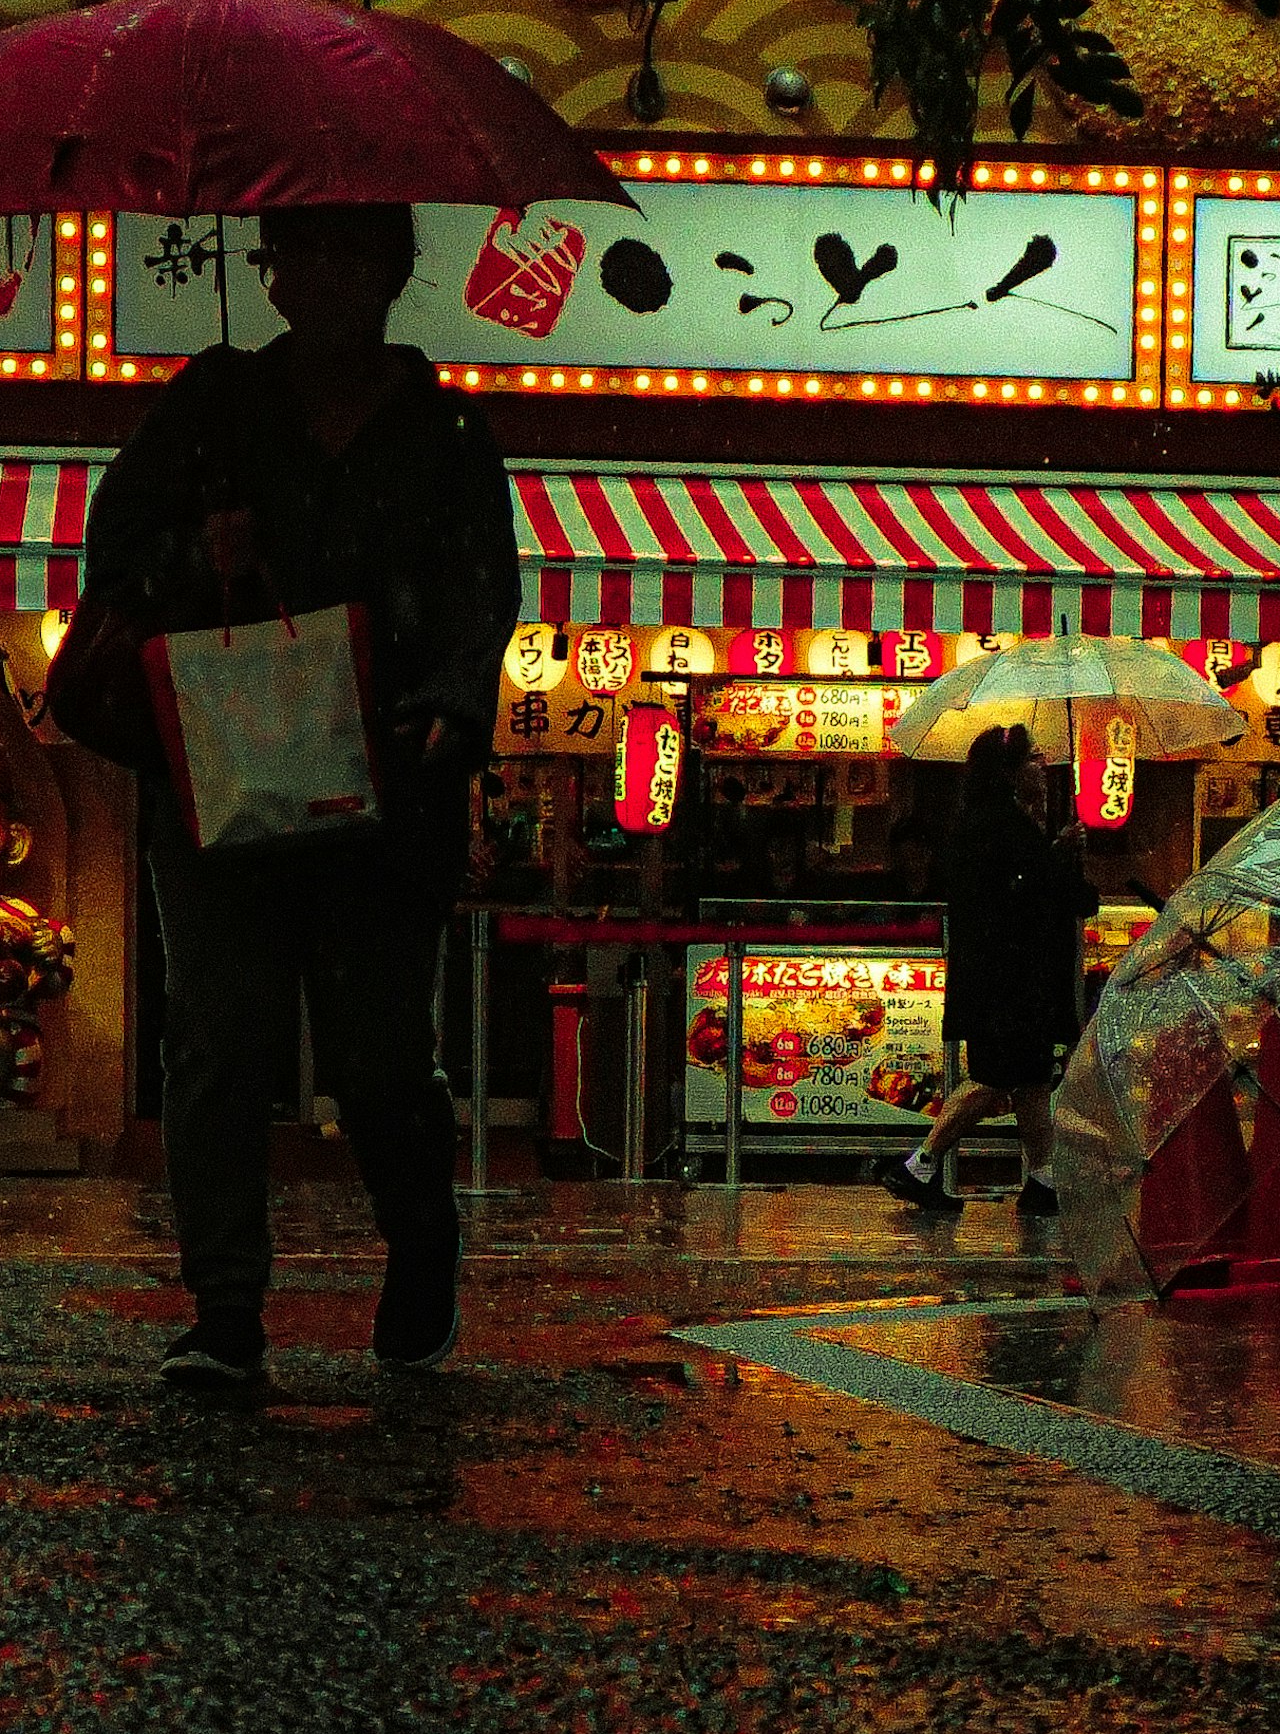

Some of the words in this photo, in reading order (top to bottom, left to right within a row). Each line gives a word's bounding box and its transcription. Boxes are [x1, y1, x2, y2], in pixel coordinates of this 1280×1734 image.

[519, 630, 543, 684] イワシ
[820, 689, 861, 706] 680円
[821, 711, 860, 728] 780円
[651, 726, 678, 823] たこ焼き
[695, 960, 872, 988] ジャボたこ焼き
[809, 1035, 859, 1056] 680円
[809, 1065, 858, 1087] 780円
